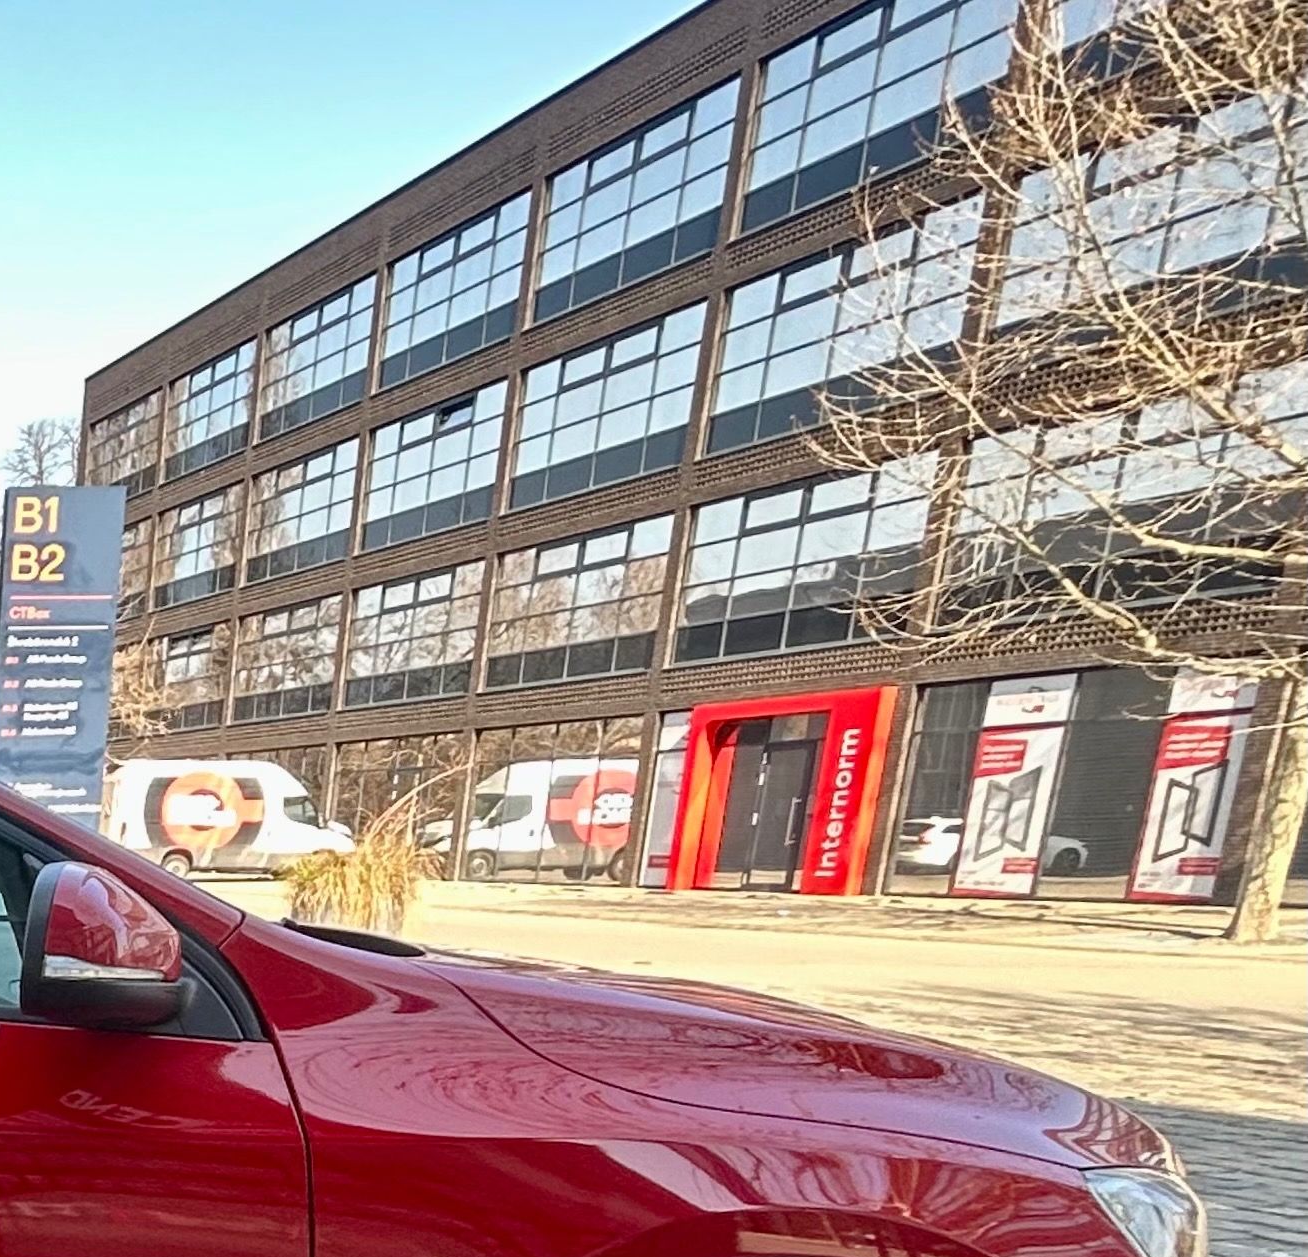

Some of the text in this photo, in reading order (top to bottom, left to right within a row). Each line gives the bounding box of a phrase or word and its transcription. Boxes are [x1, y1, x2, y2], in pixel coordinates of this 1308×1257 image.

[13, 496, 59, 533] B1
[11, 543, 65, 581] B2
[814, 728, 861, 877] Internorm
